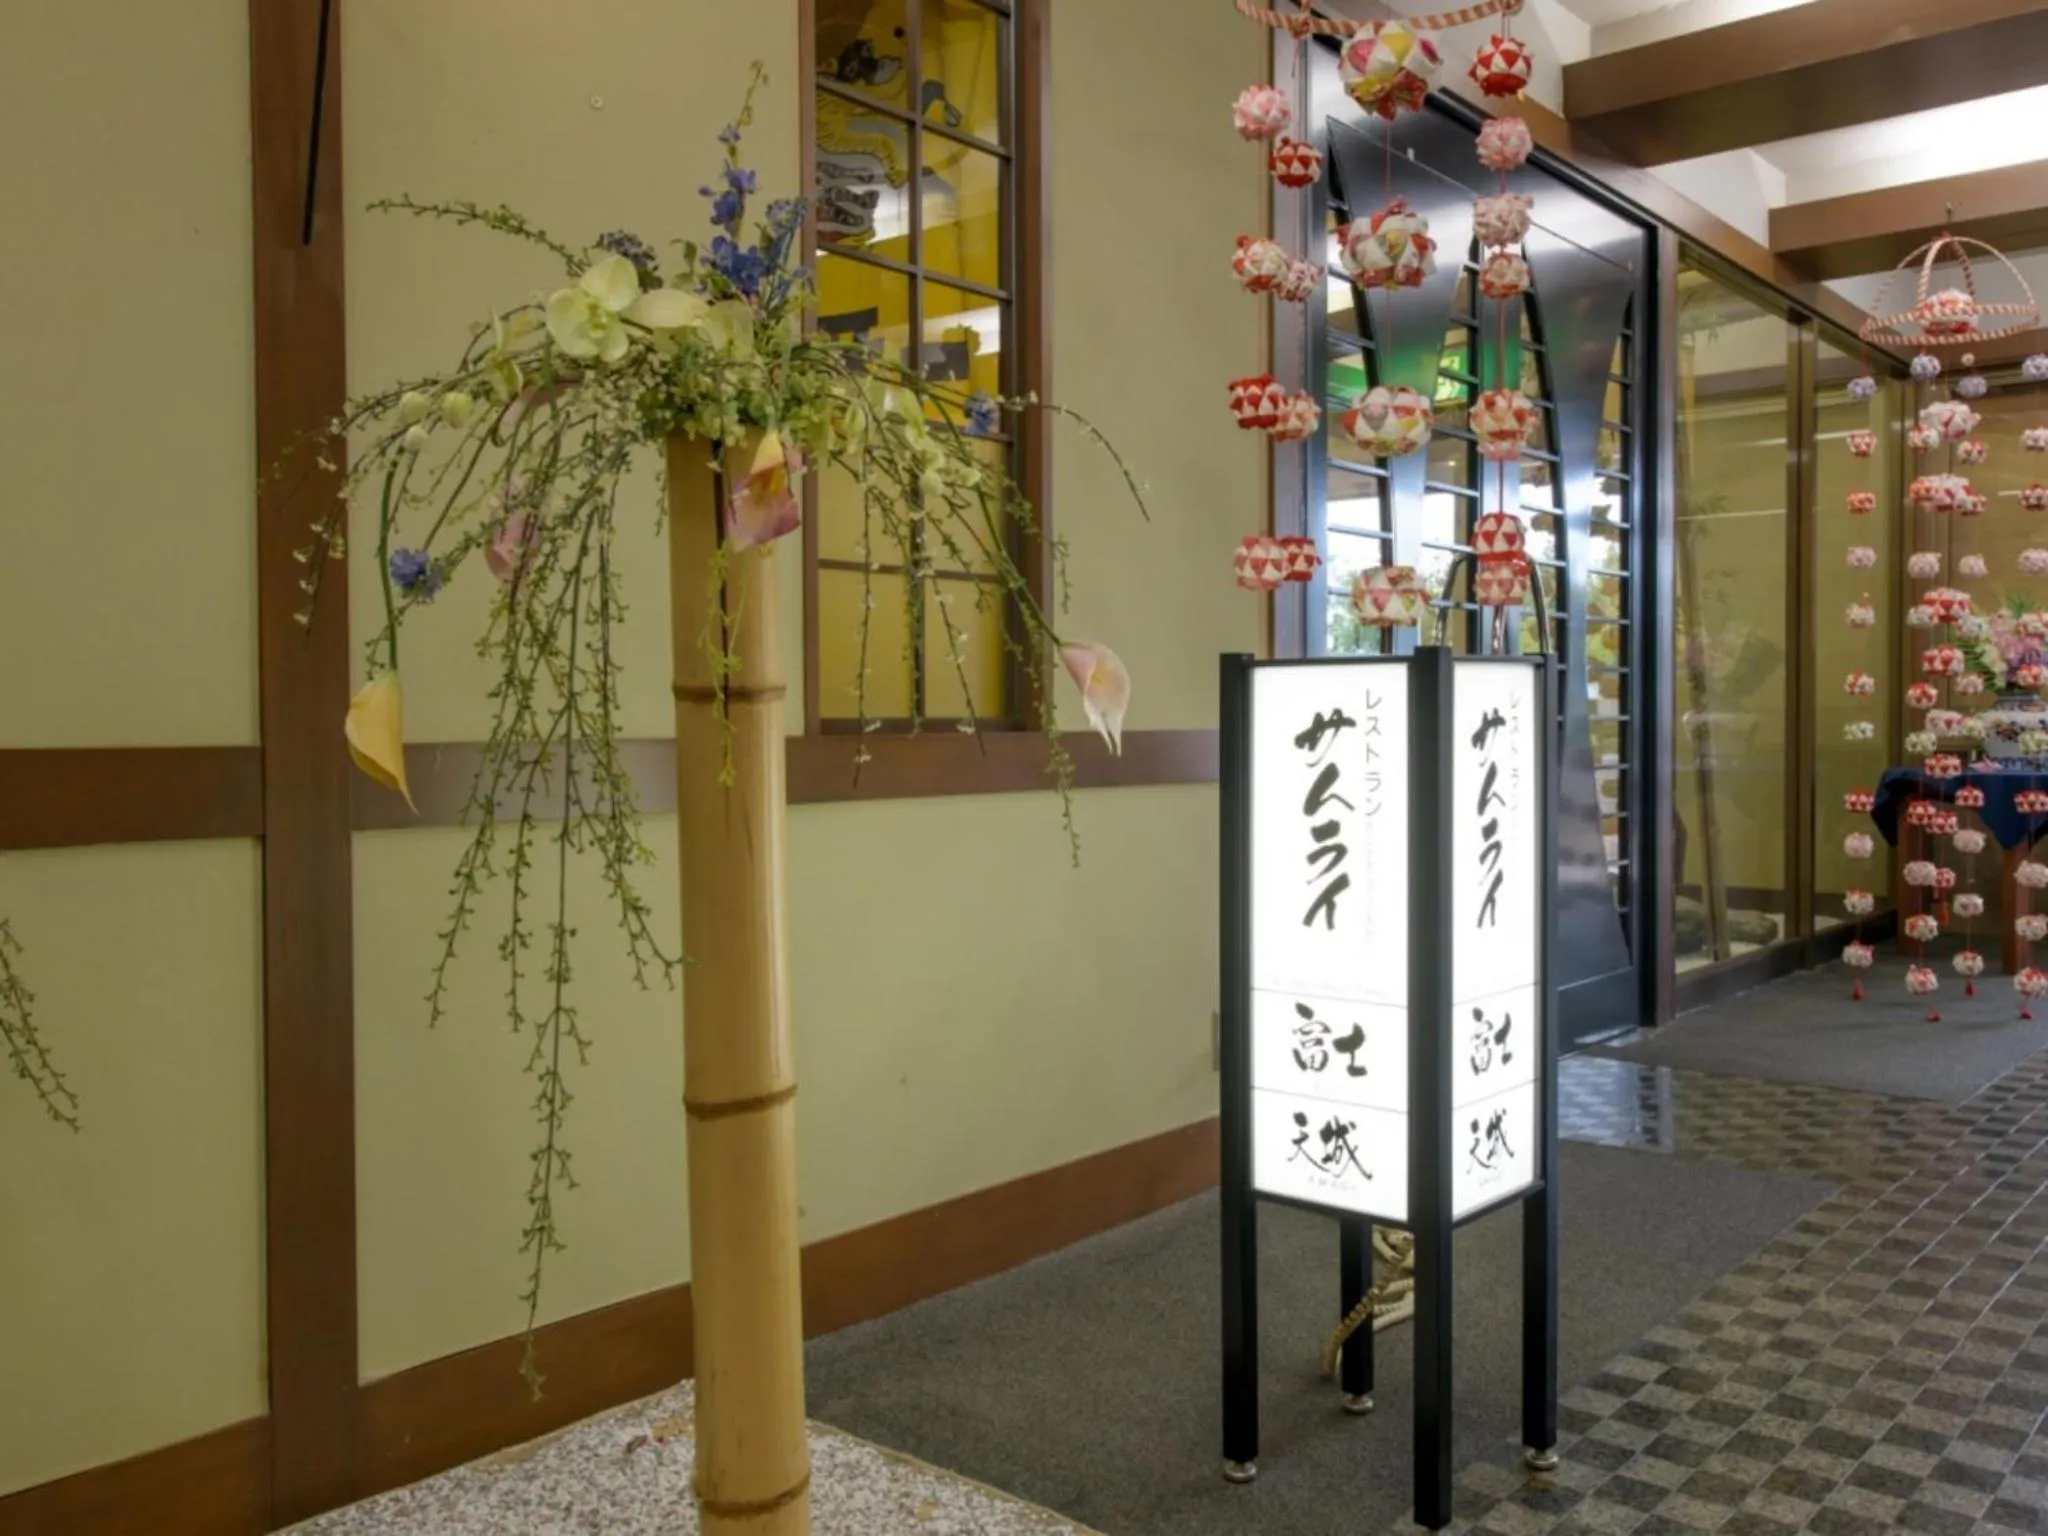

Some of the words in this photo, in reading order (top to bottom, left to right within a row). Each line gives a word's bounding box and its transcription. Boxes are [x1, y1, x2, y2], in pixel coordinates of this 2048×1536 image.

[1364, 687, 1383, 818] レストラン
[1294, 708, 1358, 931] サムライ
[1470, 707, 1507, 930] サムライ
[1292, 1002, 1367, 1078] 富士
[1470, 1007, 1513, 1077] 富士
[1287, 1111, 1374, 1181] 天城
